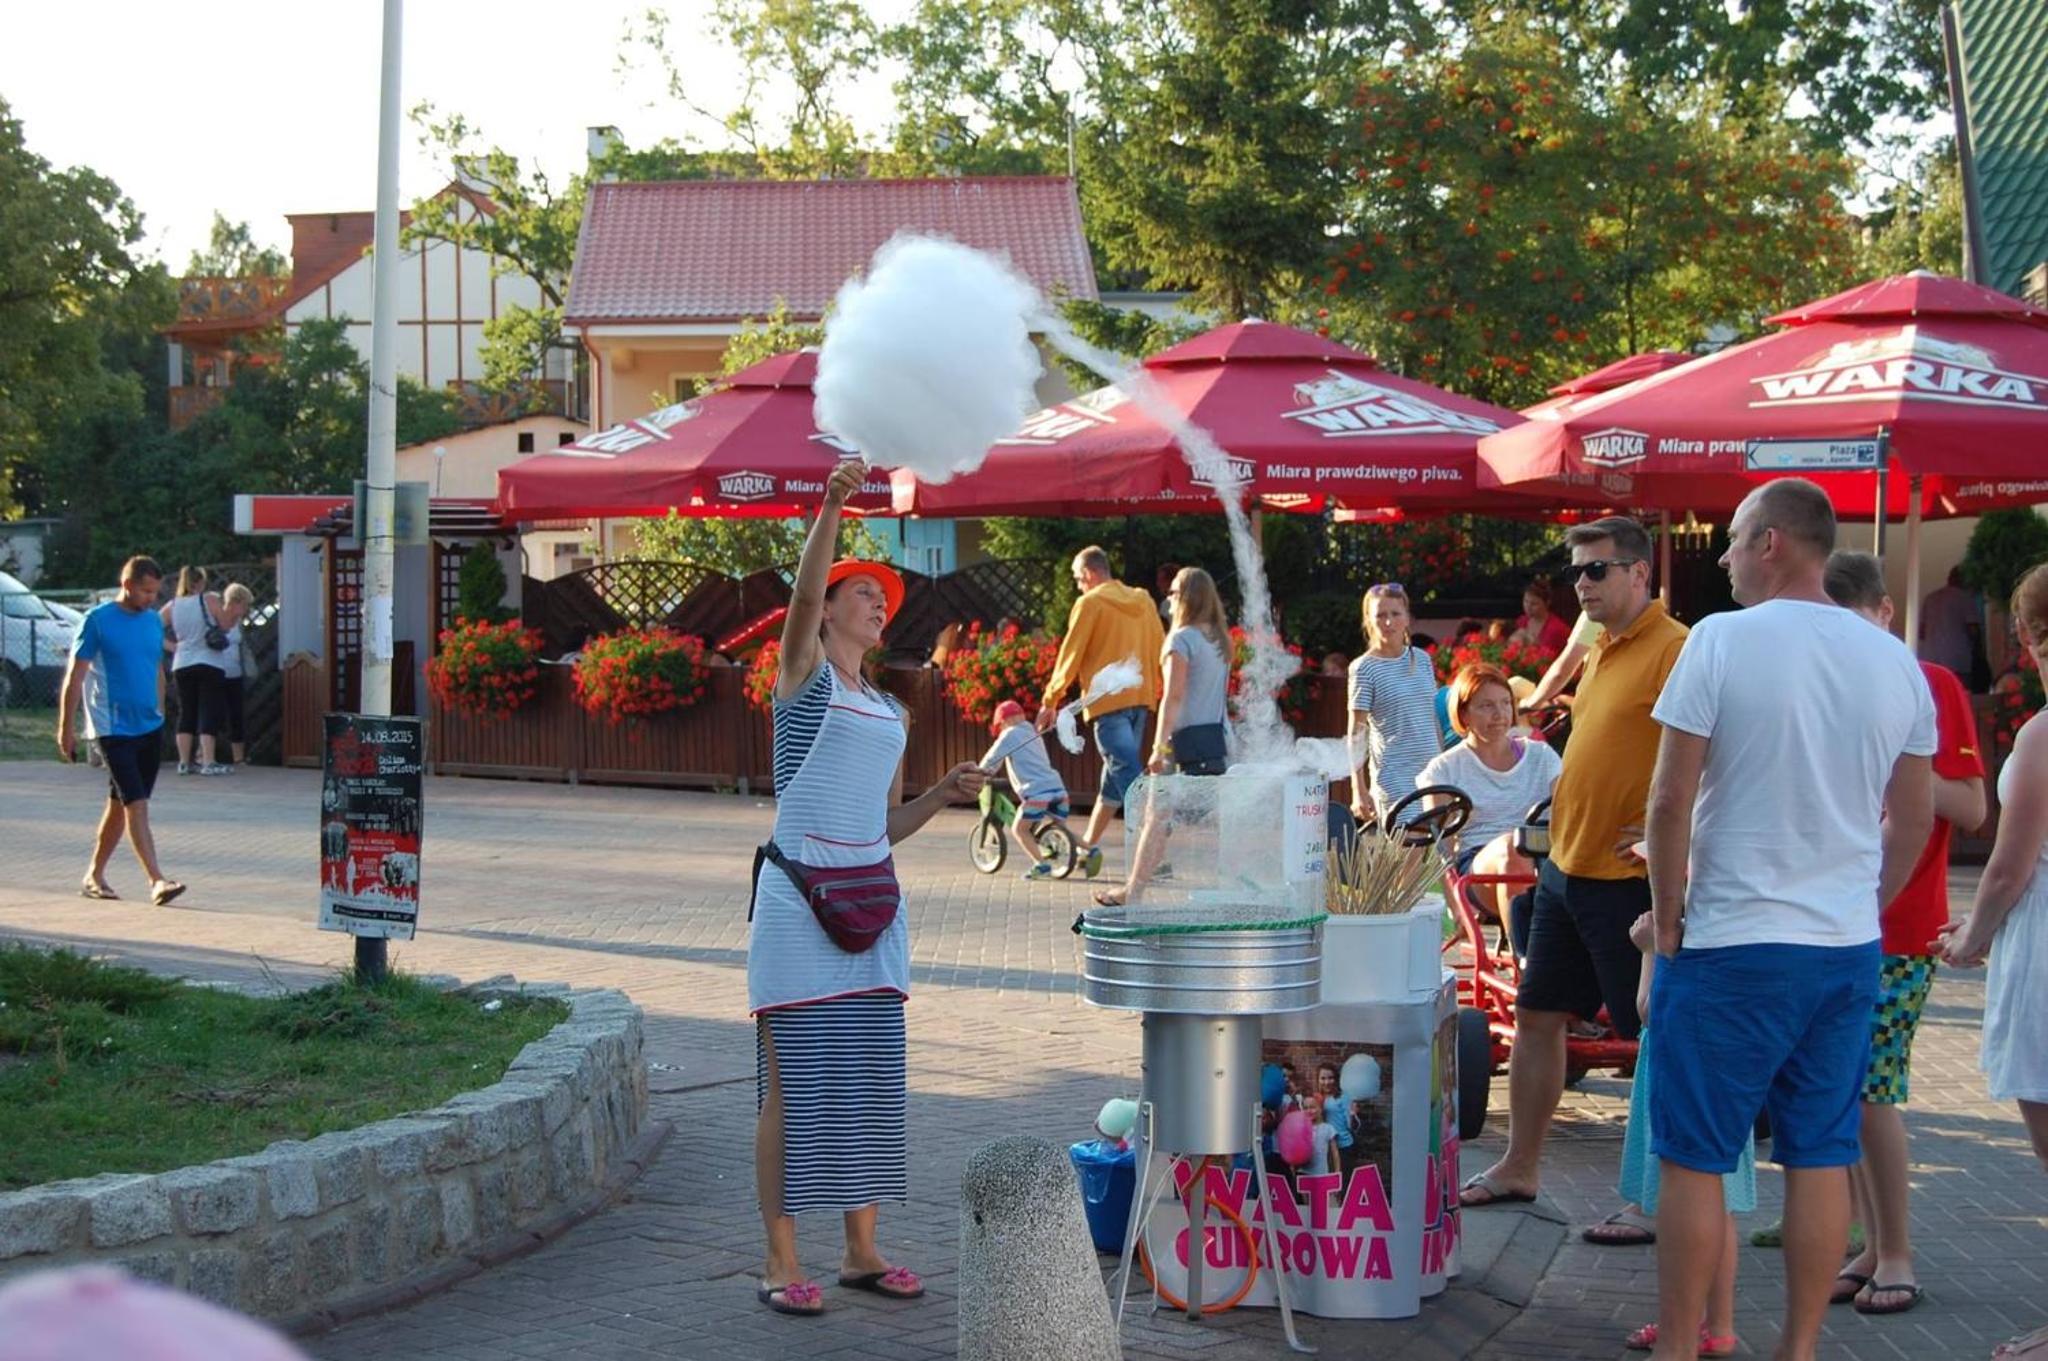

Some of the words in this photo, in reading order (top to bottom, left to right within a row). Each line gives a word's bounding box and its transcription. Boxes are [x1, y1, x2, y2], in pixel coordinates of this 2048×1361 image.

[1762, 359, 2036, 402] WARKA
[1583, 434, 1645, 458] WARKA
[1658, 438, 1704, 454] Miara
[1709, 440, 1746, 457] praw
[1267, 465, 1310, 478] Miara
[1316, 464, 1417, 482] prawdziwego
[1422, 465, 1462, 482] piwa.
[720, 477, 773, 494] WARKA
[785, 480, 824, 492] Miara
[1171, 1158, 1395, 1232] WATA
